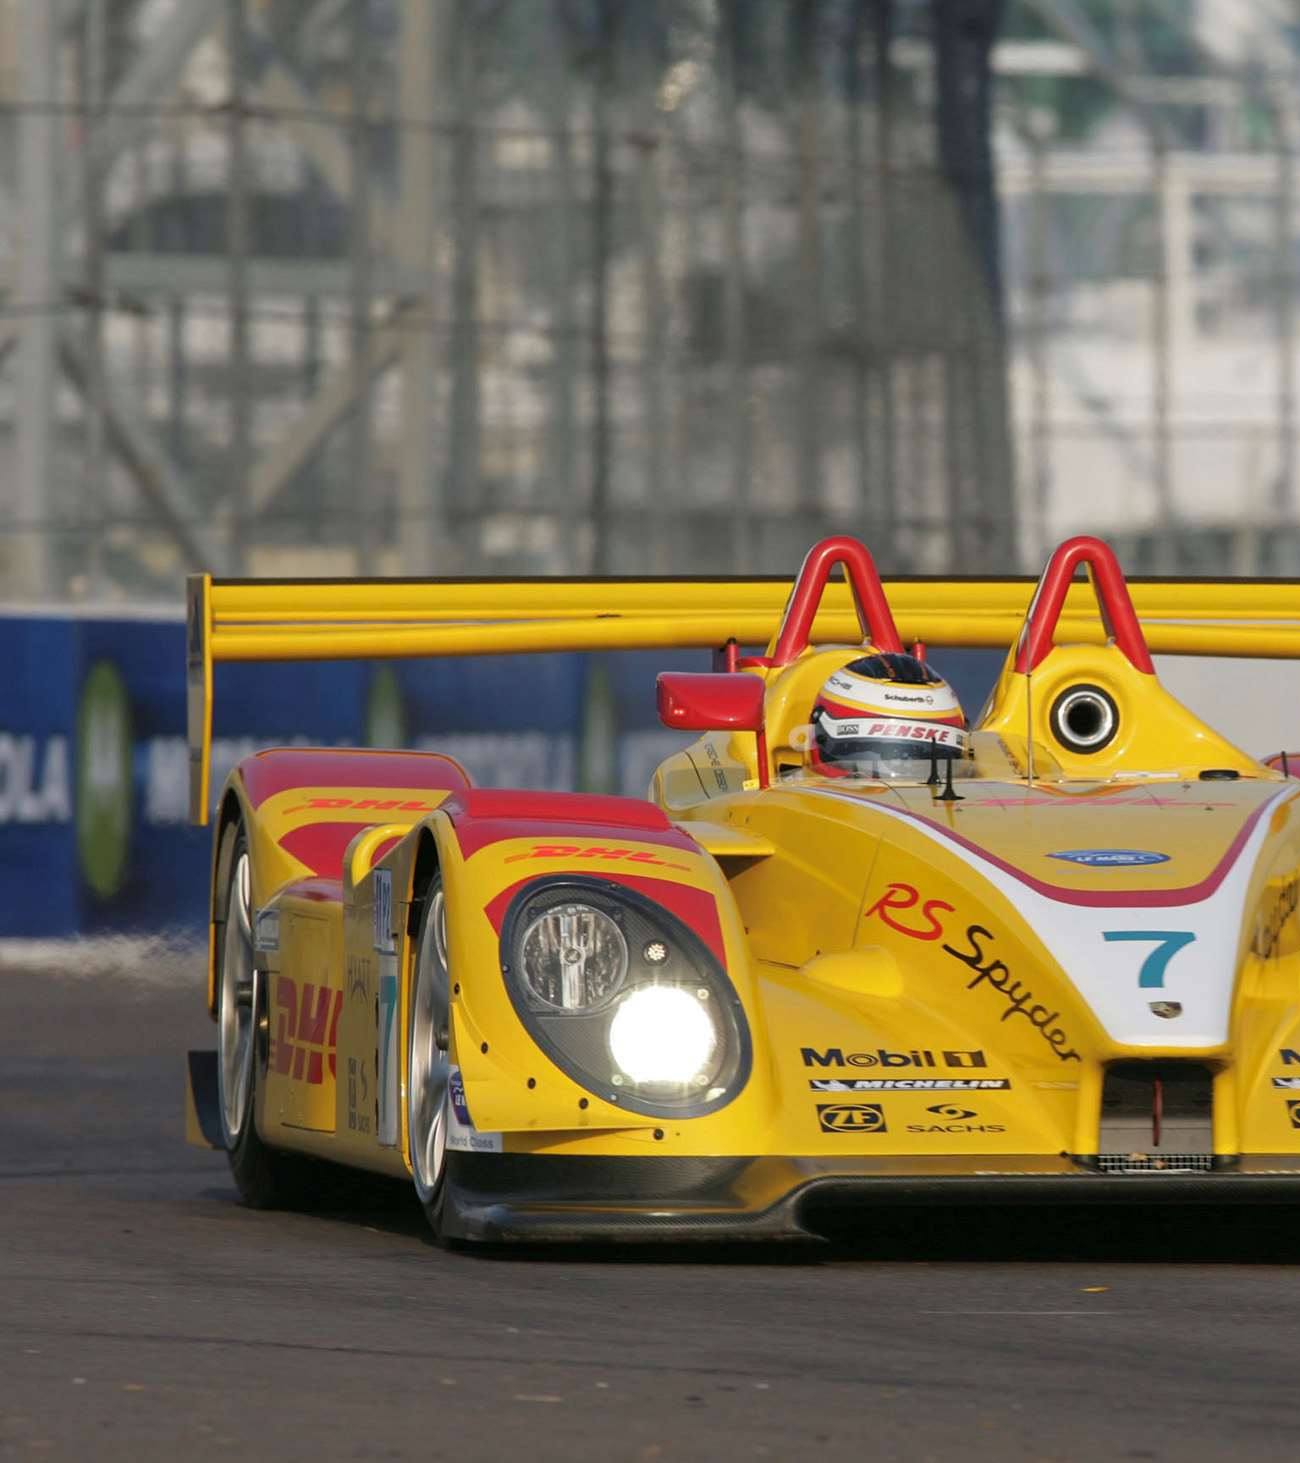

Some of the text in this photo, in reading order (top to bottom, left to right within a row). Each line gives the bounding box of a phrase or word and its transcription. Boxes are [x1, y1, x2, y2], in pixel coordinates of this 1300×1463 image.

[868, 723, 949, 742] PENSKE
[307, 798, 433, 812] DHL
[530, 845, 666, 865] DHL
[1101, 930, 1197, 989] 7
[865, 883, 1083, 1062] RS Spyder
[800, 1047, 985, 1068] Mobil 1
[853, 1079, 1005, 1090] MICHELIN
[906, 1124, 1007, 1133] SACHS
